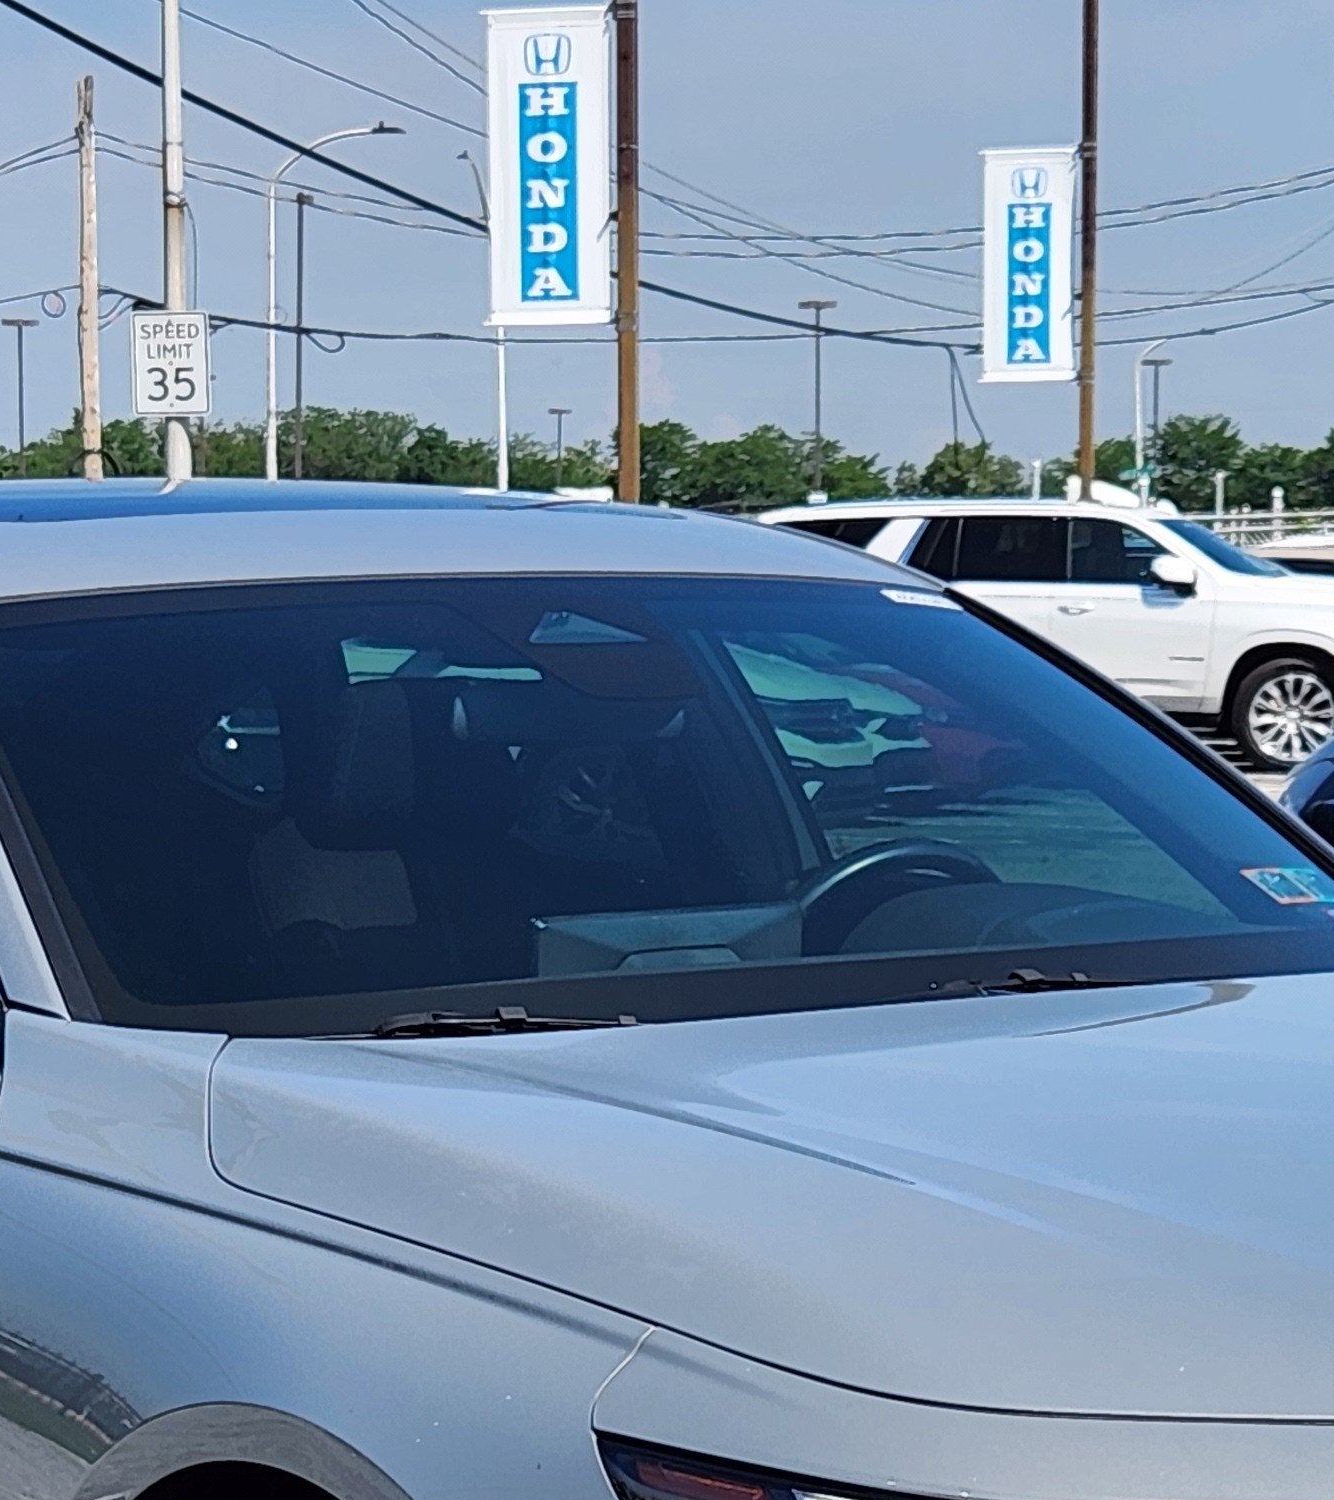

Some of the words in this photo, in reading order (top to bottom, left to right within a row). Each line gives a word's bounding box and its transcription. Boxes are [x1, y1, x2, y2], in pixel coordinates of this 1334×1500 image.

[524, 87, 573, 297] HONDA
[1011, 206, 1046, 361] HONDA
[140, 323, 200, 340] SPEED
[147, 343, 193, 359] LIMIT
[147, 367, 196, 401] 35
